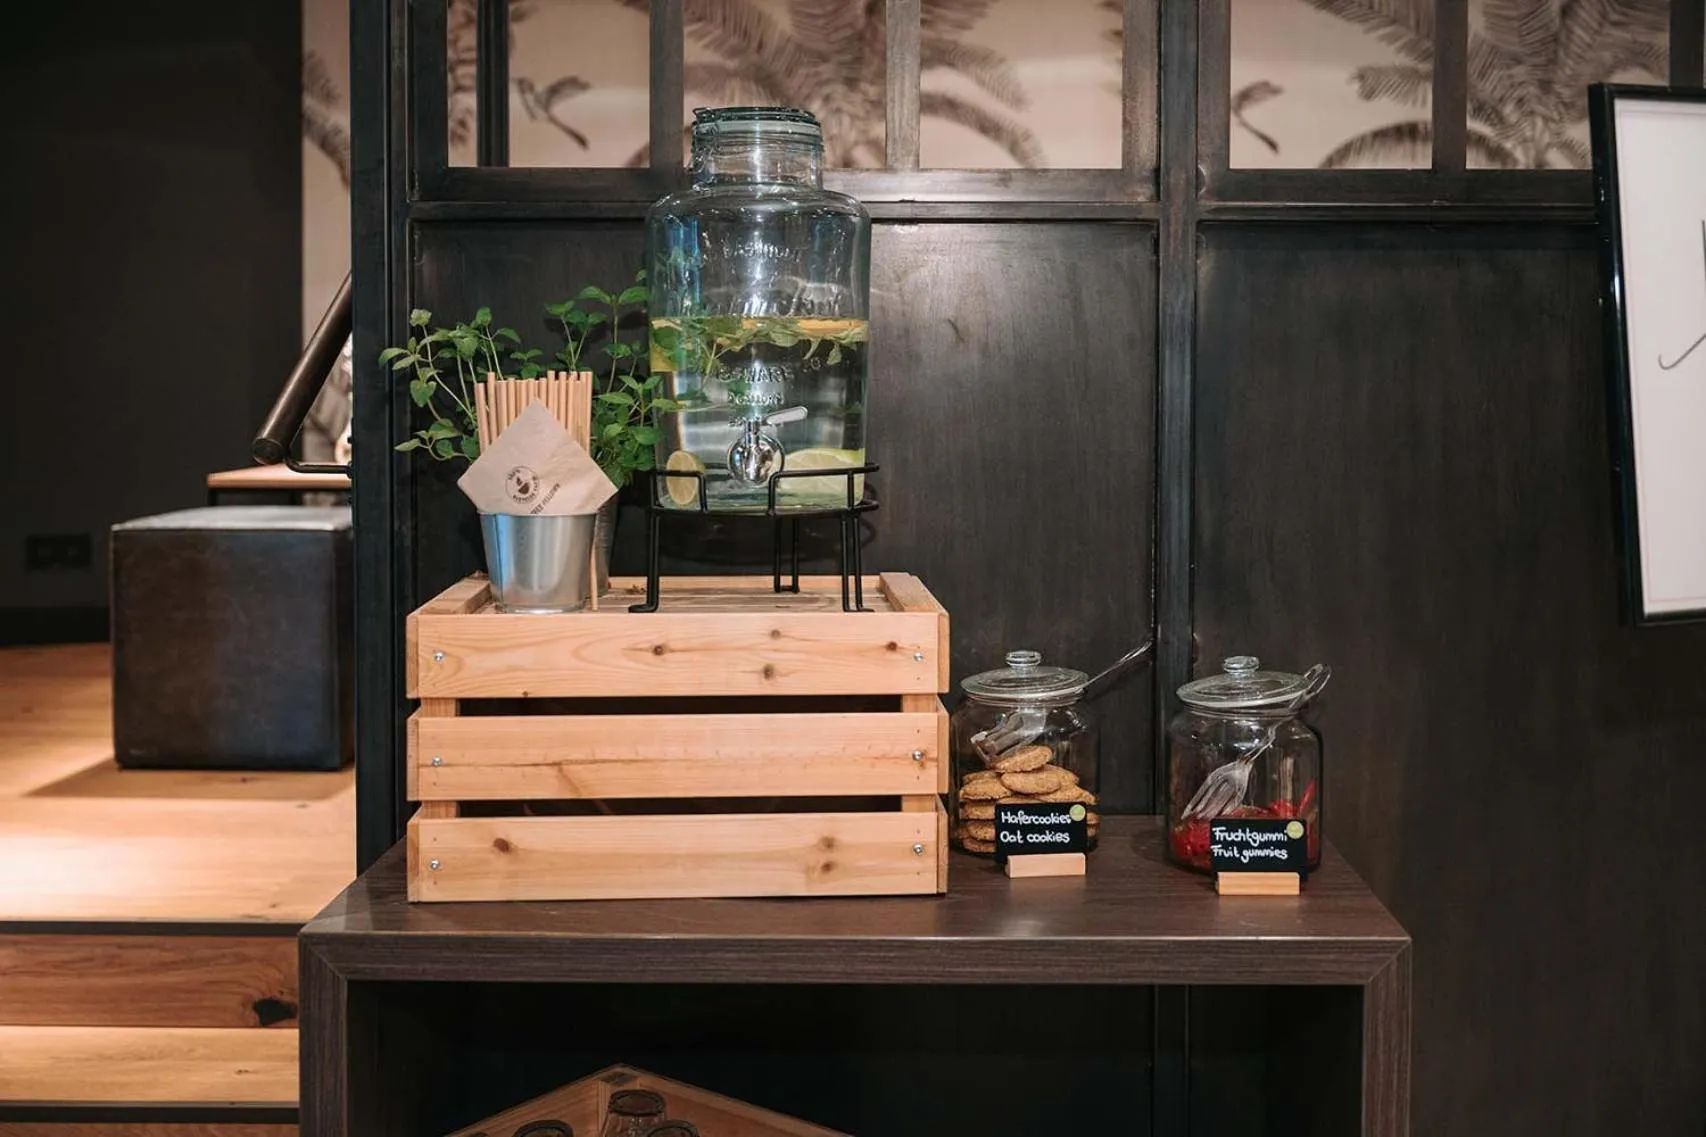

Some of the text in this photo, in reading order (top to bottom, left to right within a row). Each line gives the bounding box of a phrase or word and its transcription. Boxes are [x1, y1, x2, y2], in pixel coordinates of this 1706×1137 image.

[1001, 810, 1071, 825] Hafercookies
[1000, 829, 1071, 844] Oat cookies
[1210, 844, 1288, 863] Fruit gummies
